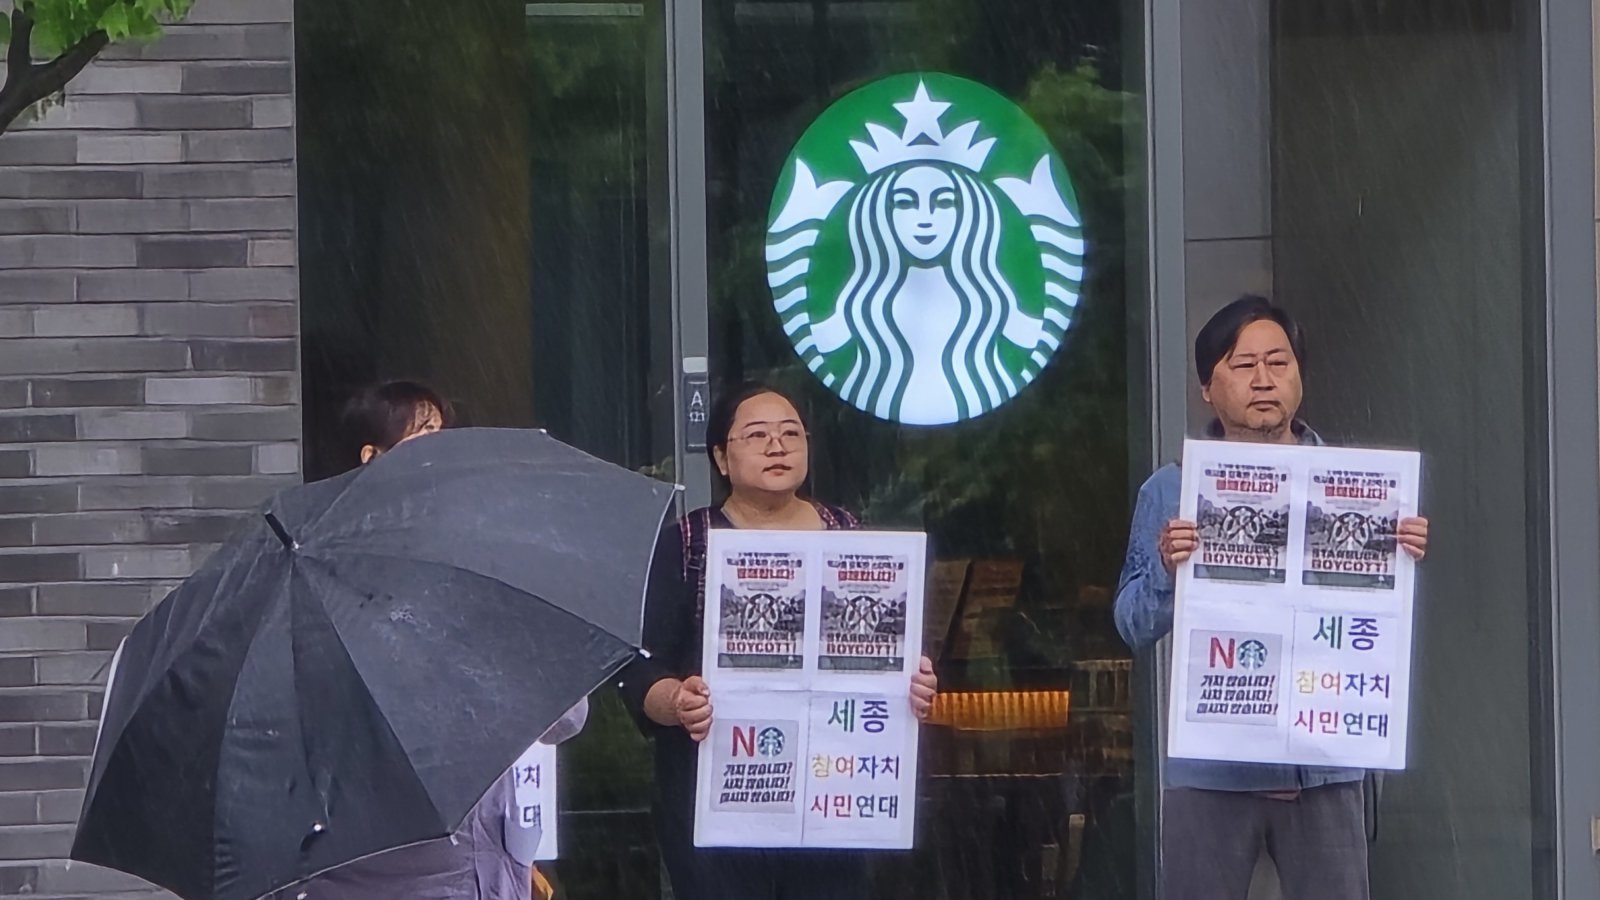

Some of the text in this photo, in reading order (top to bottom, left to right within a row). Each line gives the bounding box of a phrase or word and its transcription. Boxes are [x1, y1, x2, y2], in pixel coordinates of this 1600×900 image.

[1203, 552, 1279, 568] BOYCOTT!
[1311, 558, 1388, 573] BOYCOTT!
[1313, 616, 1379, 650] 세종
[726, 641, 796, 654] BOYCOTT!
[827, 643, 897, 656] BOYCOTT!
[1297, 671, 1390, 699] 참여자치
[828, 699, 889, 733] 세종
[1294, 709, 1388, 738] 시민연대
[812, 754, 900, 780] 참여자치
[811, 794, 898, 819] 시민연대
